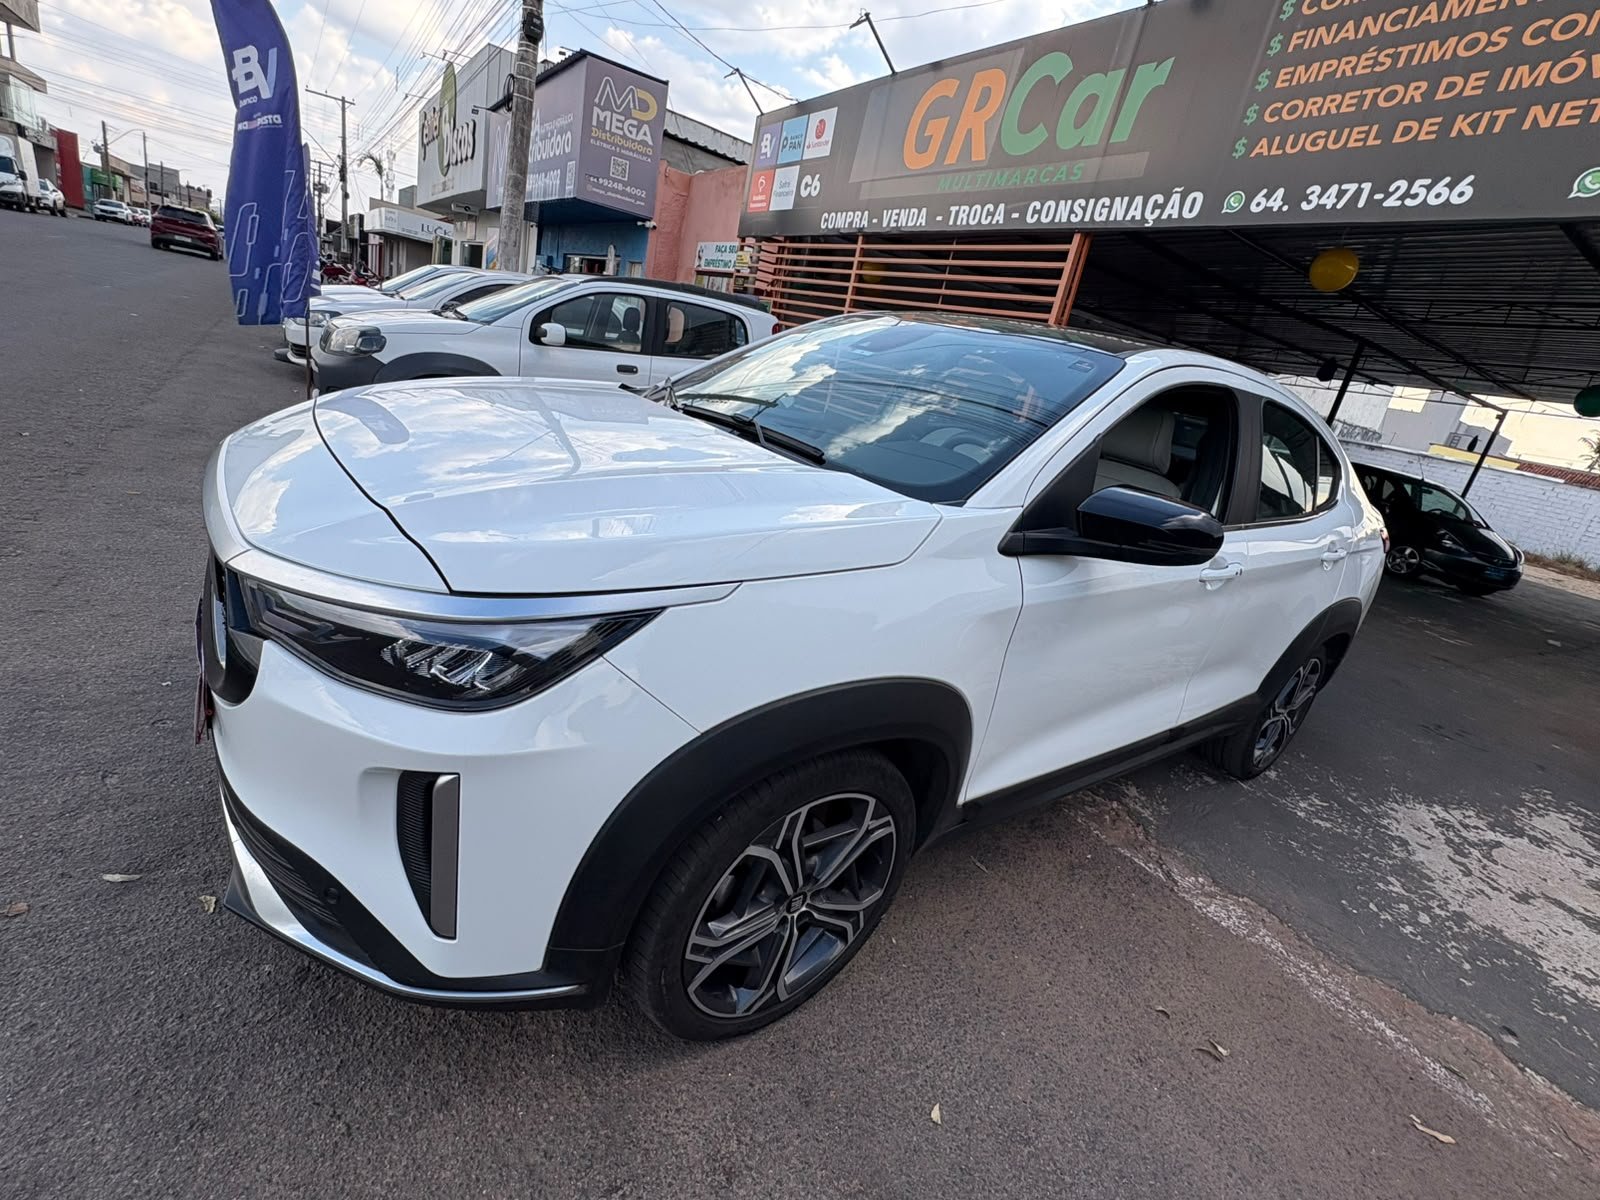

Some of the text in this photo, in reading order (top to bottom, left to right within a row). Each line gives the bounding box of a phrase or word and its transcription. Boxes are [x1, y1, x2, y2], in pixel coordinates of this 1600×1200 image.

[1274, 26, 1513, 89] EMPRÉSTIMOS
[1263, 80, 1428, 123] CORRETOR
[1434, 70, 1490, 101] DE
[591, 105, 654, 146] MEGA
[591, 126, 653, 155] Distribuidora
[1249, 124, 1382, 158] ALUGUEL
[1392, 116, 1443, 144] DE
[1449, 108, 1517, 138] KIT
[598, 177, 646, 198] 99248-4002
[800, 174, 820, 197] C6
[937, 161, 1086, 193] MULTIMARCAS
[820, 211, 869, 229] COMPRA
[882, 208, 927, 227] VENDA
[949, 203, 1005, 226] TROCA
[1025, 186, 1204, 227] CONSIGNAÇÃO
[1250, 187, 1289, 213] 64.
[1300, 174, 1475, 211] 3471-2566
